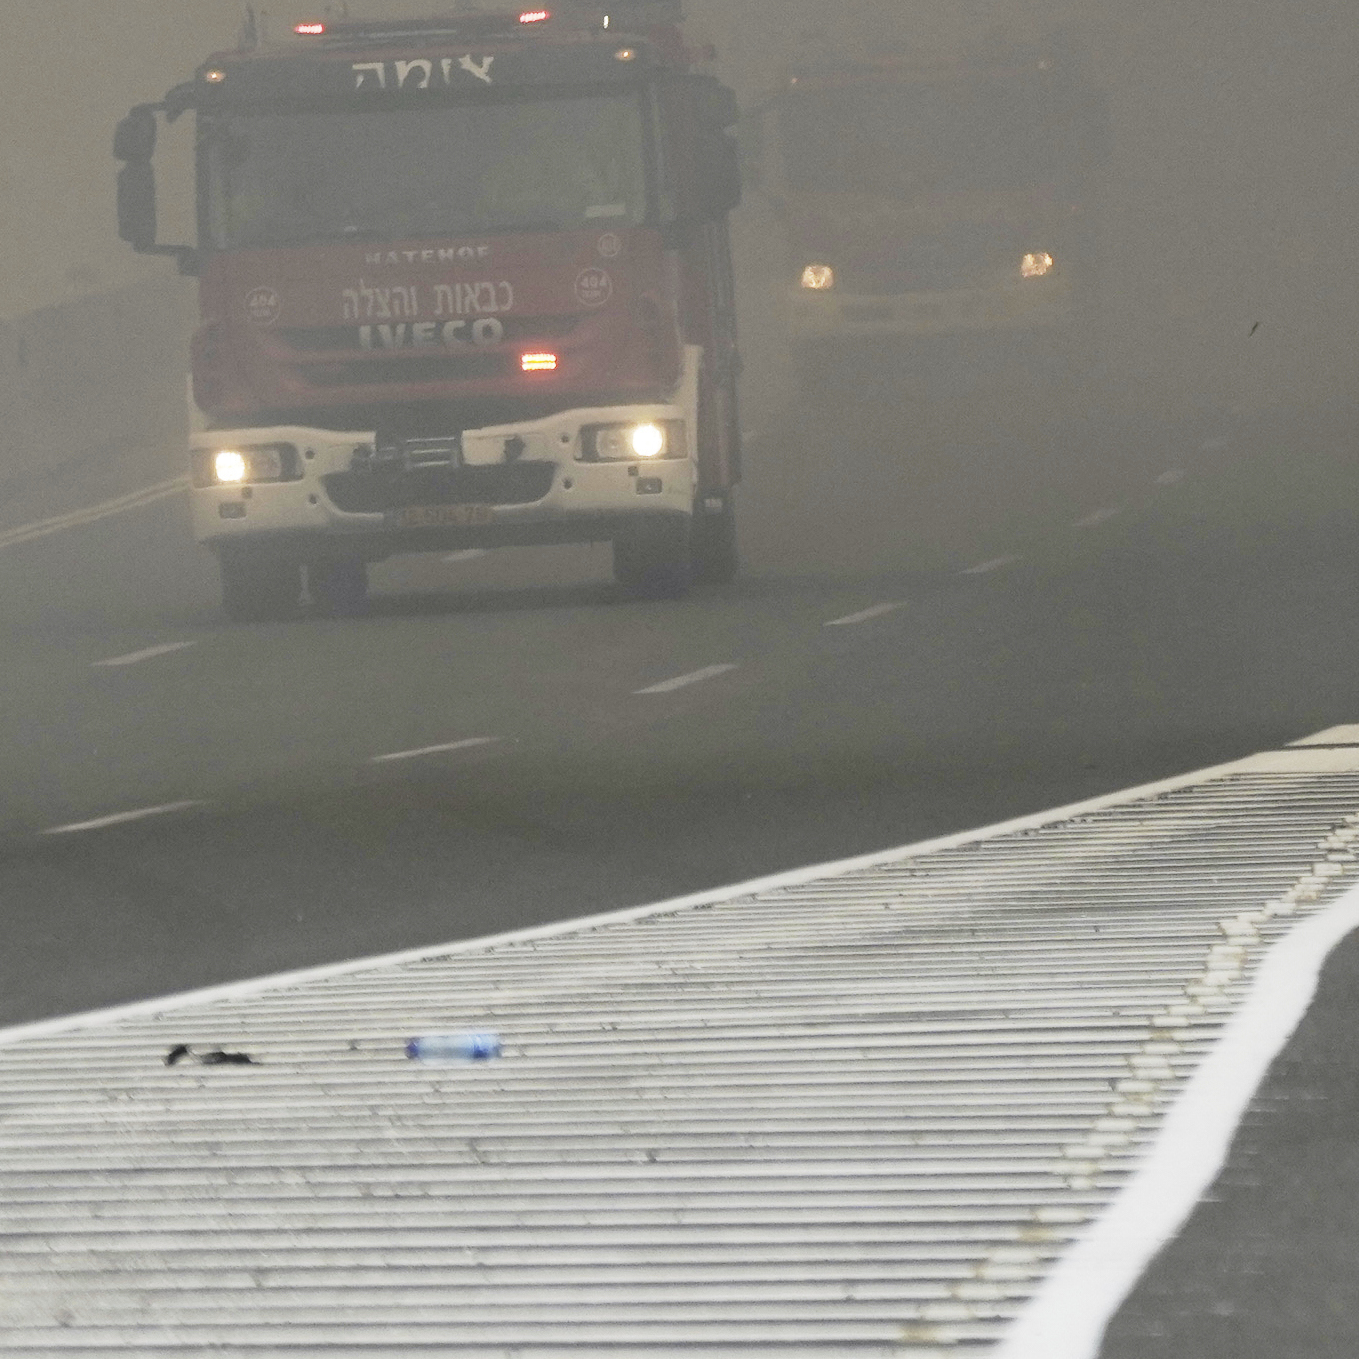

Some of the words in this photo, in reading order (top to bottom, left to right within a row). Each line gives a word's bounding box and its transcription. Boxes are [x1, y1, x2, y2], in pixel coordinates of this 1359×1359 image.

[341, 278, 419, 319] והצלה
[433, 280, 515, 316] כבאות
[358, 317, 505, 350] IVECO
